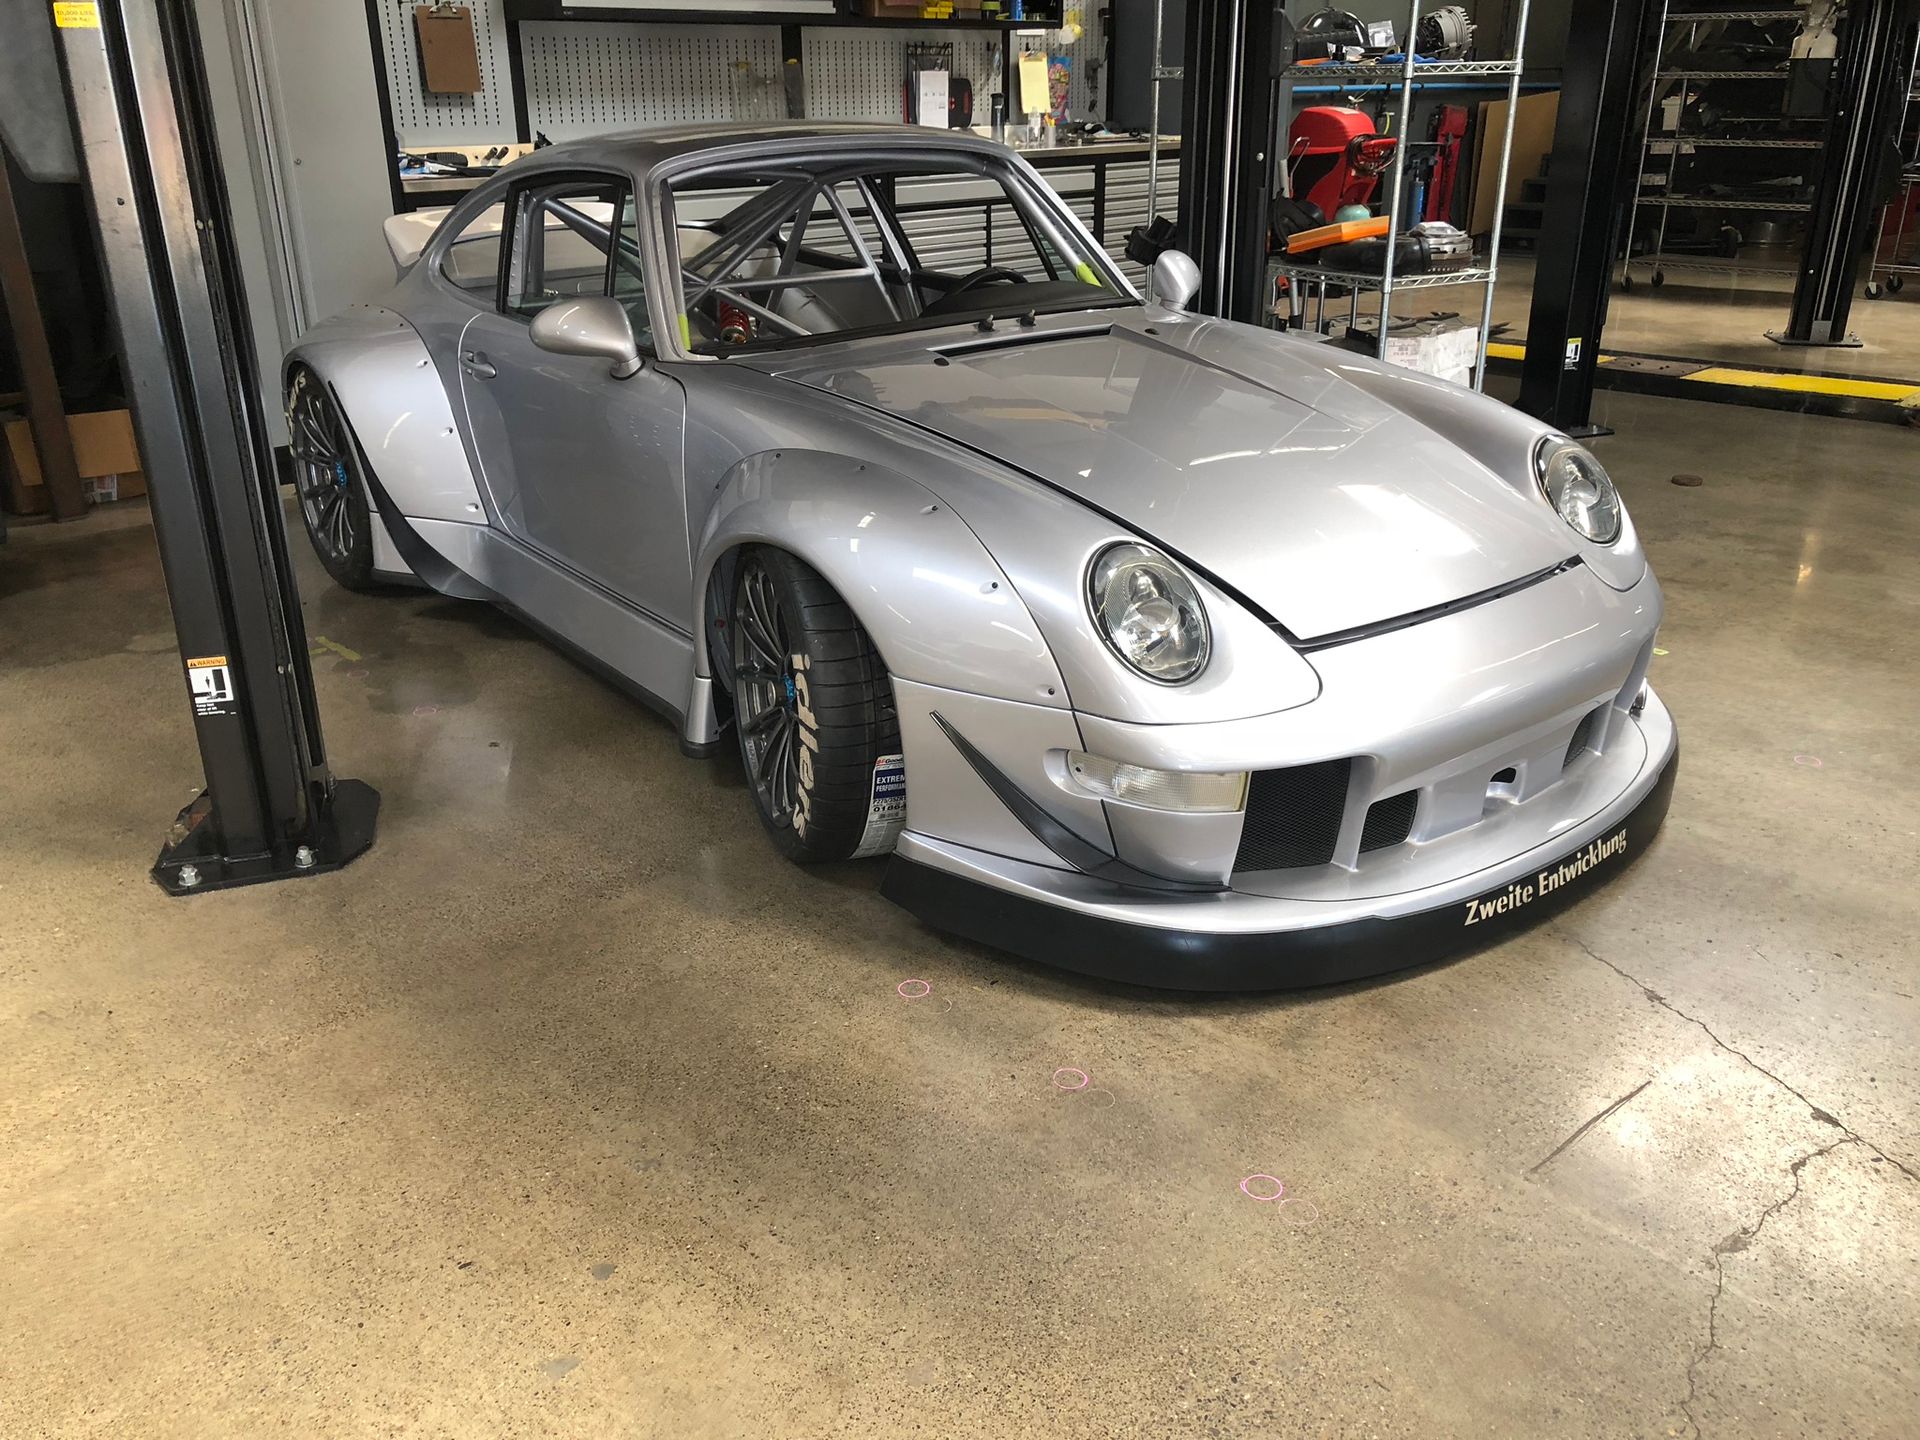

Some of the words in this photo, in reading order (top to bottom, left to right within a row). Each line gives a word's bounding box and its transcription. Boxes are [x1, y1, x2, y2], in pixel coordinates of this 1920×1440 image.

[197, 658, 225, 667] WARNING
[1464, 884, 1533, 926] Zweite
[1538, 828, 1627, 897] Entwicklung
